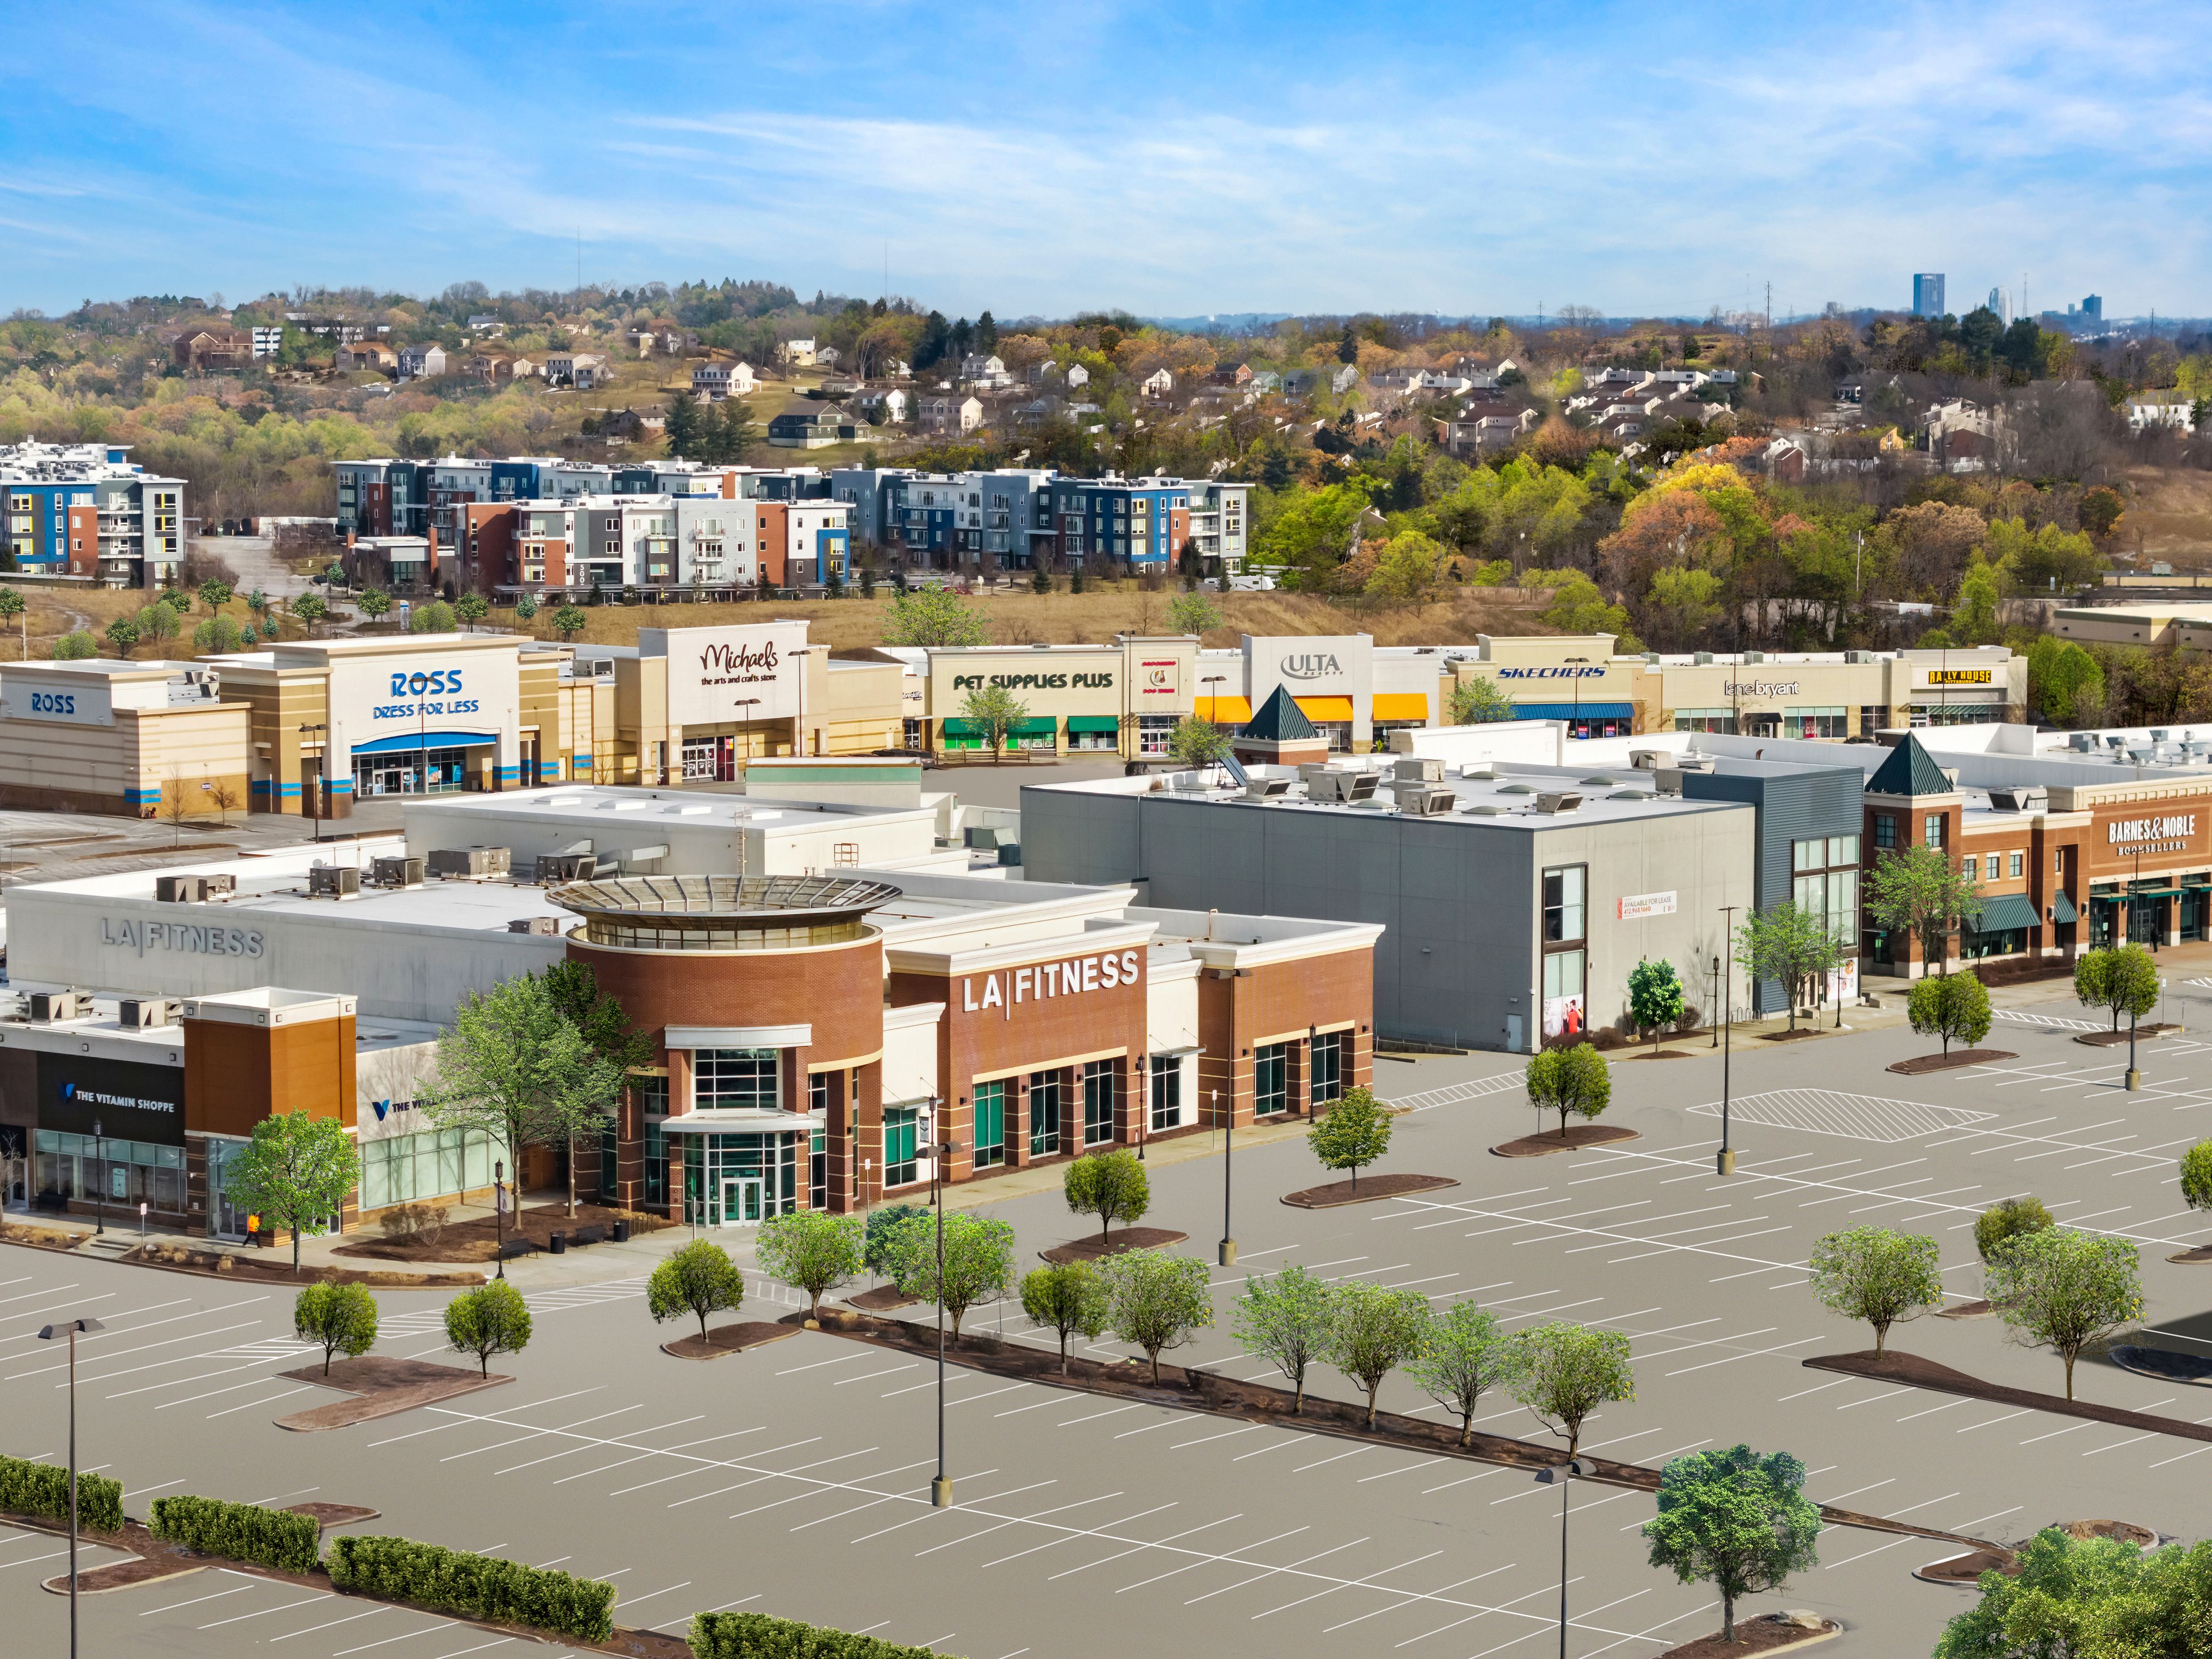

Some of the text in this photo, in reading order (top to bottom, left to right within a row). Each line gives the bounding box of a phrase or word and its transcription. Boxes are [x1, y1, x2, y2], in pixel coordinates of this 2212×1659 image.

[700, 641, 778, 674] Michaels
[1289, 654, 1340, 672] ULTA
[728, 675, 740, 683] and
[741, 674, 759, 683] crafts
[953, 673, 1113, 691] PET SUPPLIES PLUS
[1496, 667, 1607, 679] SKECHERS
[1960, 670, 1991, 683] HOUSE
[391, 670, 462, 697] ROSS
[32, 693, 76, 714] ROSS
[373, 700, 479, 719] DRESS FOR LESS
[2118, 841, 2187, 856] BOOKSELLERS
[1624, 899, 1648, 908] AVAILABLE
[146, 921, 264, 959] FITNESS
[1014, 950, 1138, 1003] FITNESS
[76, 1090, 175, 1113] THE VITAMIN SHOPPE
[392, 1101, 409, 1113] THE
